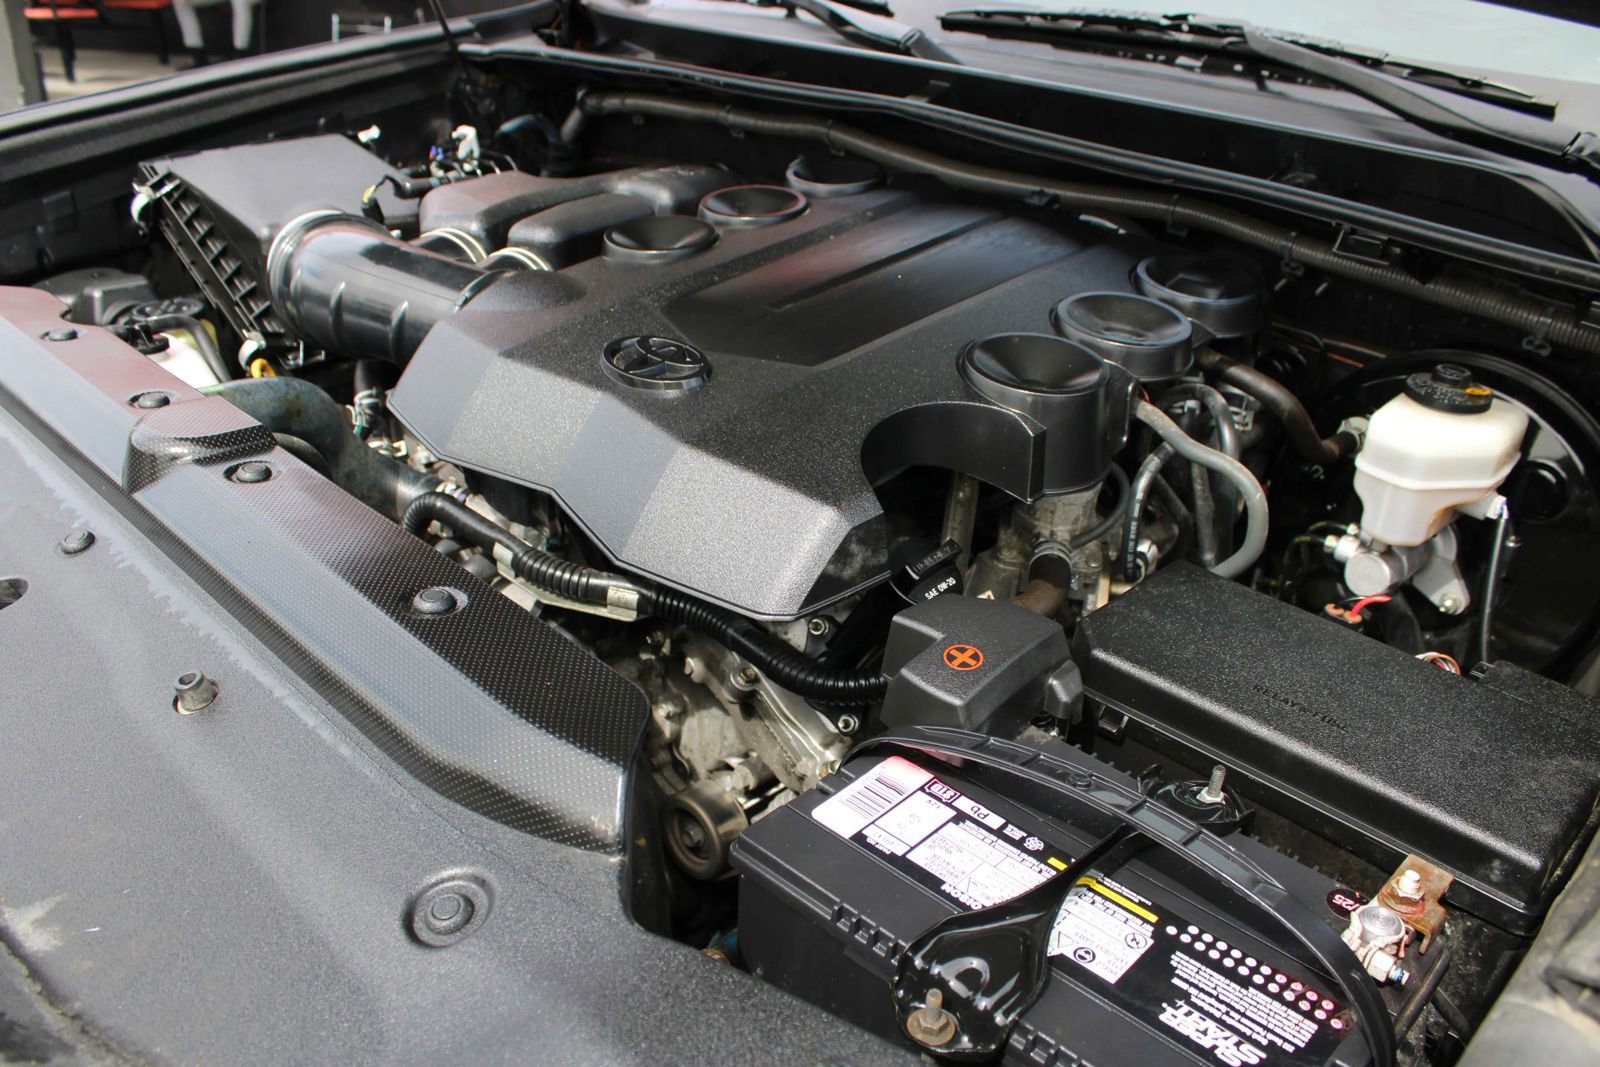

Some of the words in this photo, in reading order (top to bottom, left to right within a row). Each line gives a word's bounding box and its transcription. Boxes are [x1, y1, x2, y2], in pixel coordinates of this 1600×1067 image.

[924, 587, 939, 600] SAE
[938, 577, 956, 592] 0W-20
[930, 782, 955, 798] STD
[967, 804, 991, 820] Pb
[940, 881, 985, 911] OISON
[1331, 893, 1359, 911] /25
[1157, 1009, 1240, 1067] SUPER
[1167, 1004, 1267, 1064] START
